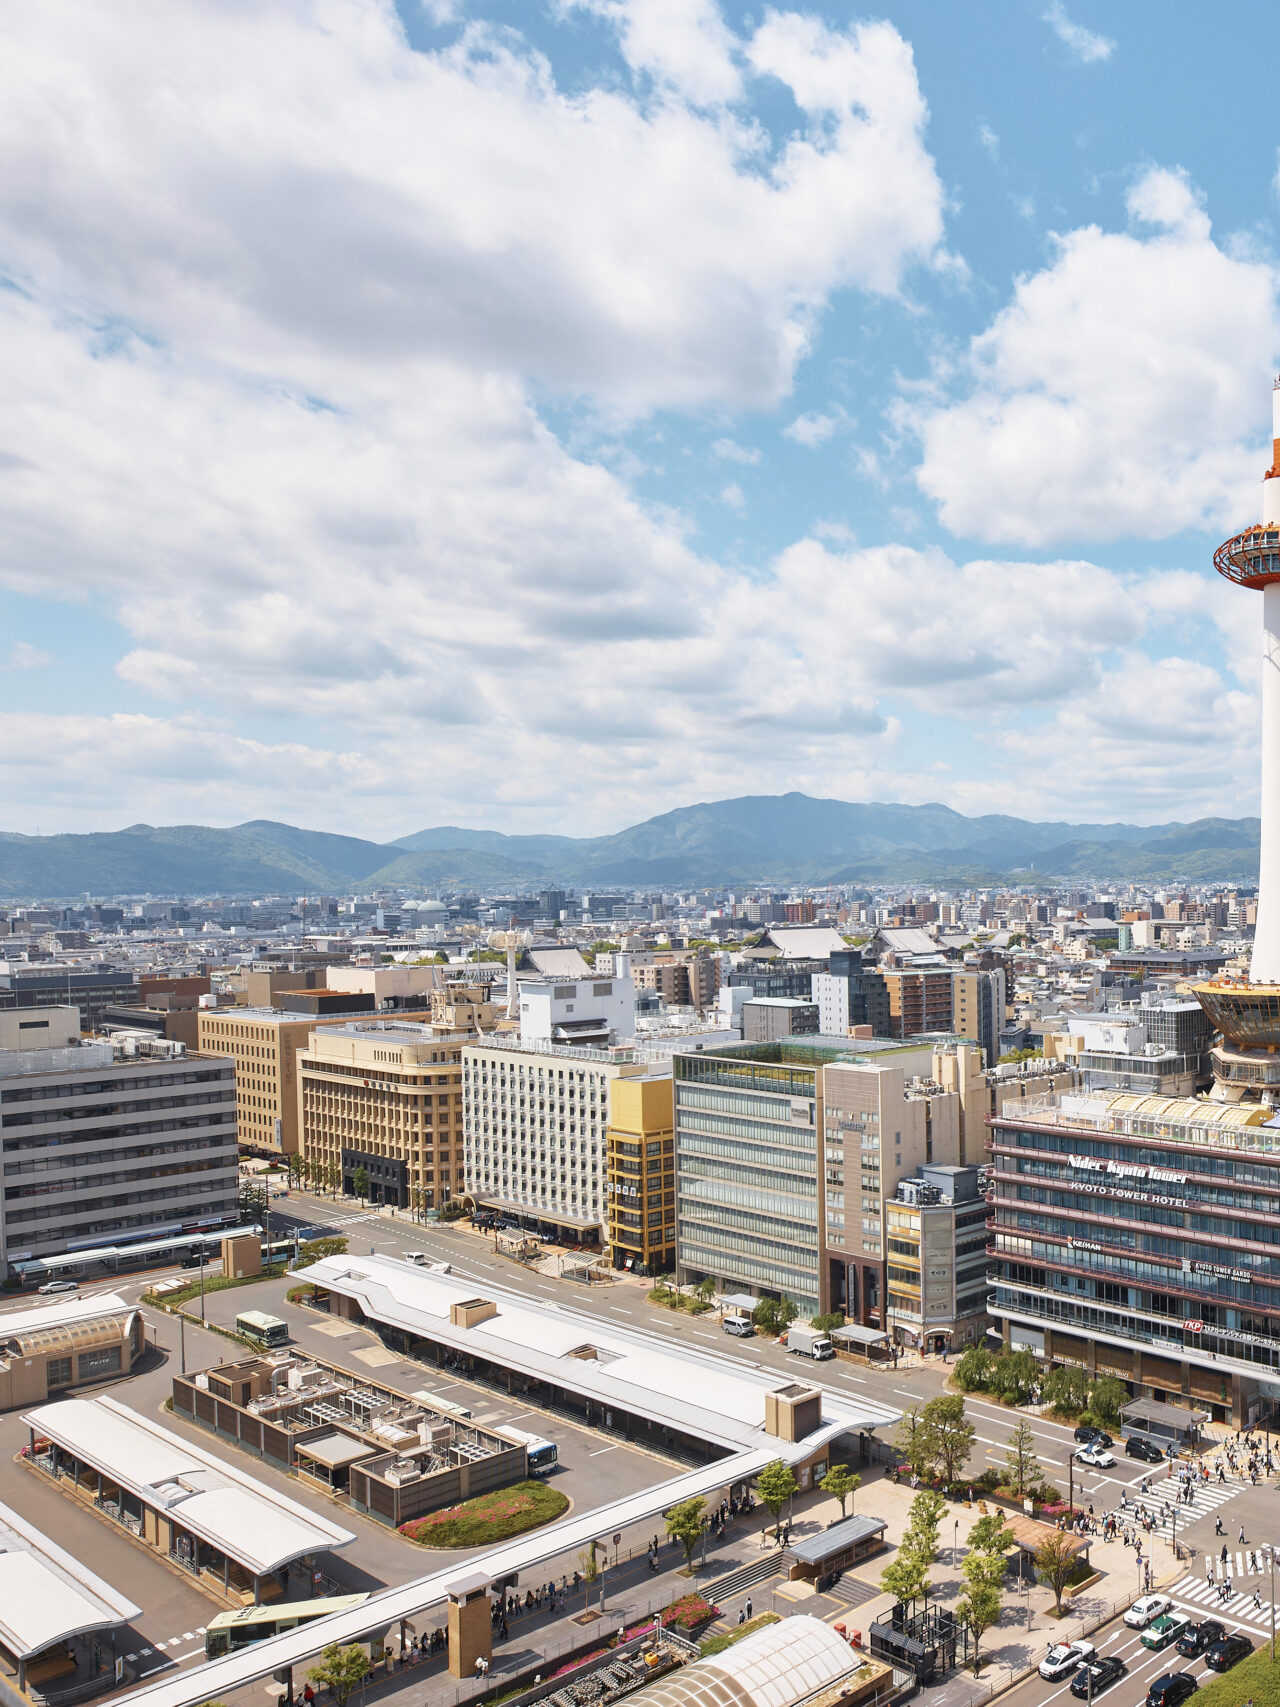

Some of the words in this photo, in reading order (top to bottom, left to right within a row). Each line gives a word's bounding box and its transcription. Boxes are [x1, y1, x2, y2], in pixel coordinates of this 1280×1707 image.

[1067, 1154, 1104, 1172] Nidec
[1106, 1160, 1147, 1179] Kyoto
[1148, 1166, 1189, 1184] Tower
[1070, 1182, 1106, 1195] KYOTO
[1110, 1187, 1148, 1201] TOWER
[1152, 1194, 1189, 1208] HOTEL
[1072, 1239, 1101, 1251] KEIHAN
[1195, 1262, 1213, 1272] KYOTO
[1213, 1264, 1231, 1275] TOWER
[1232, 1268, 1251, 1279] SANDO
[1184, 1320, 1201, 1330] TKP
